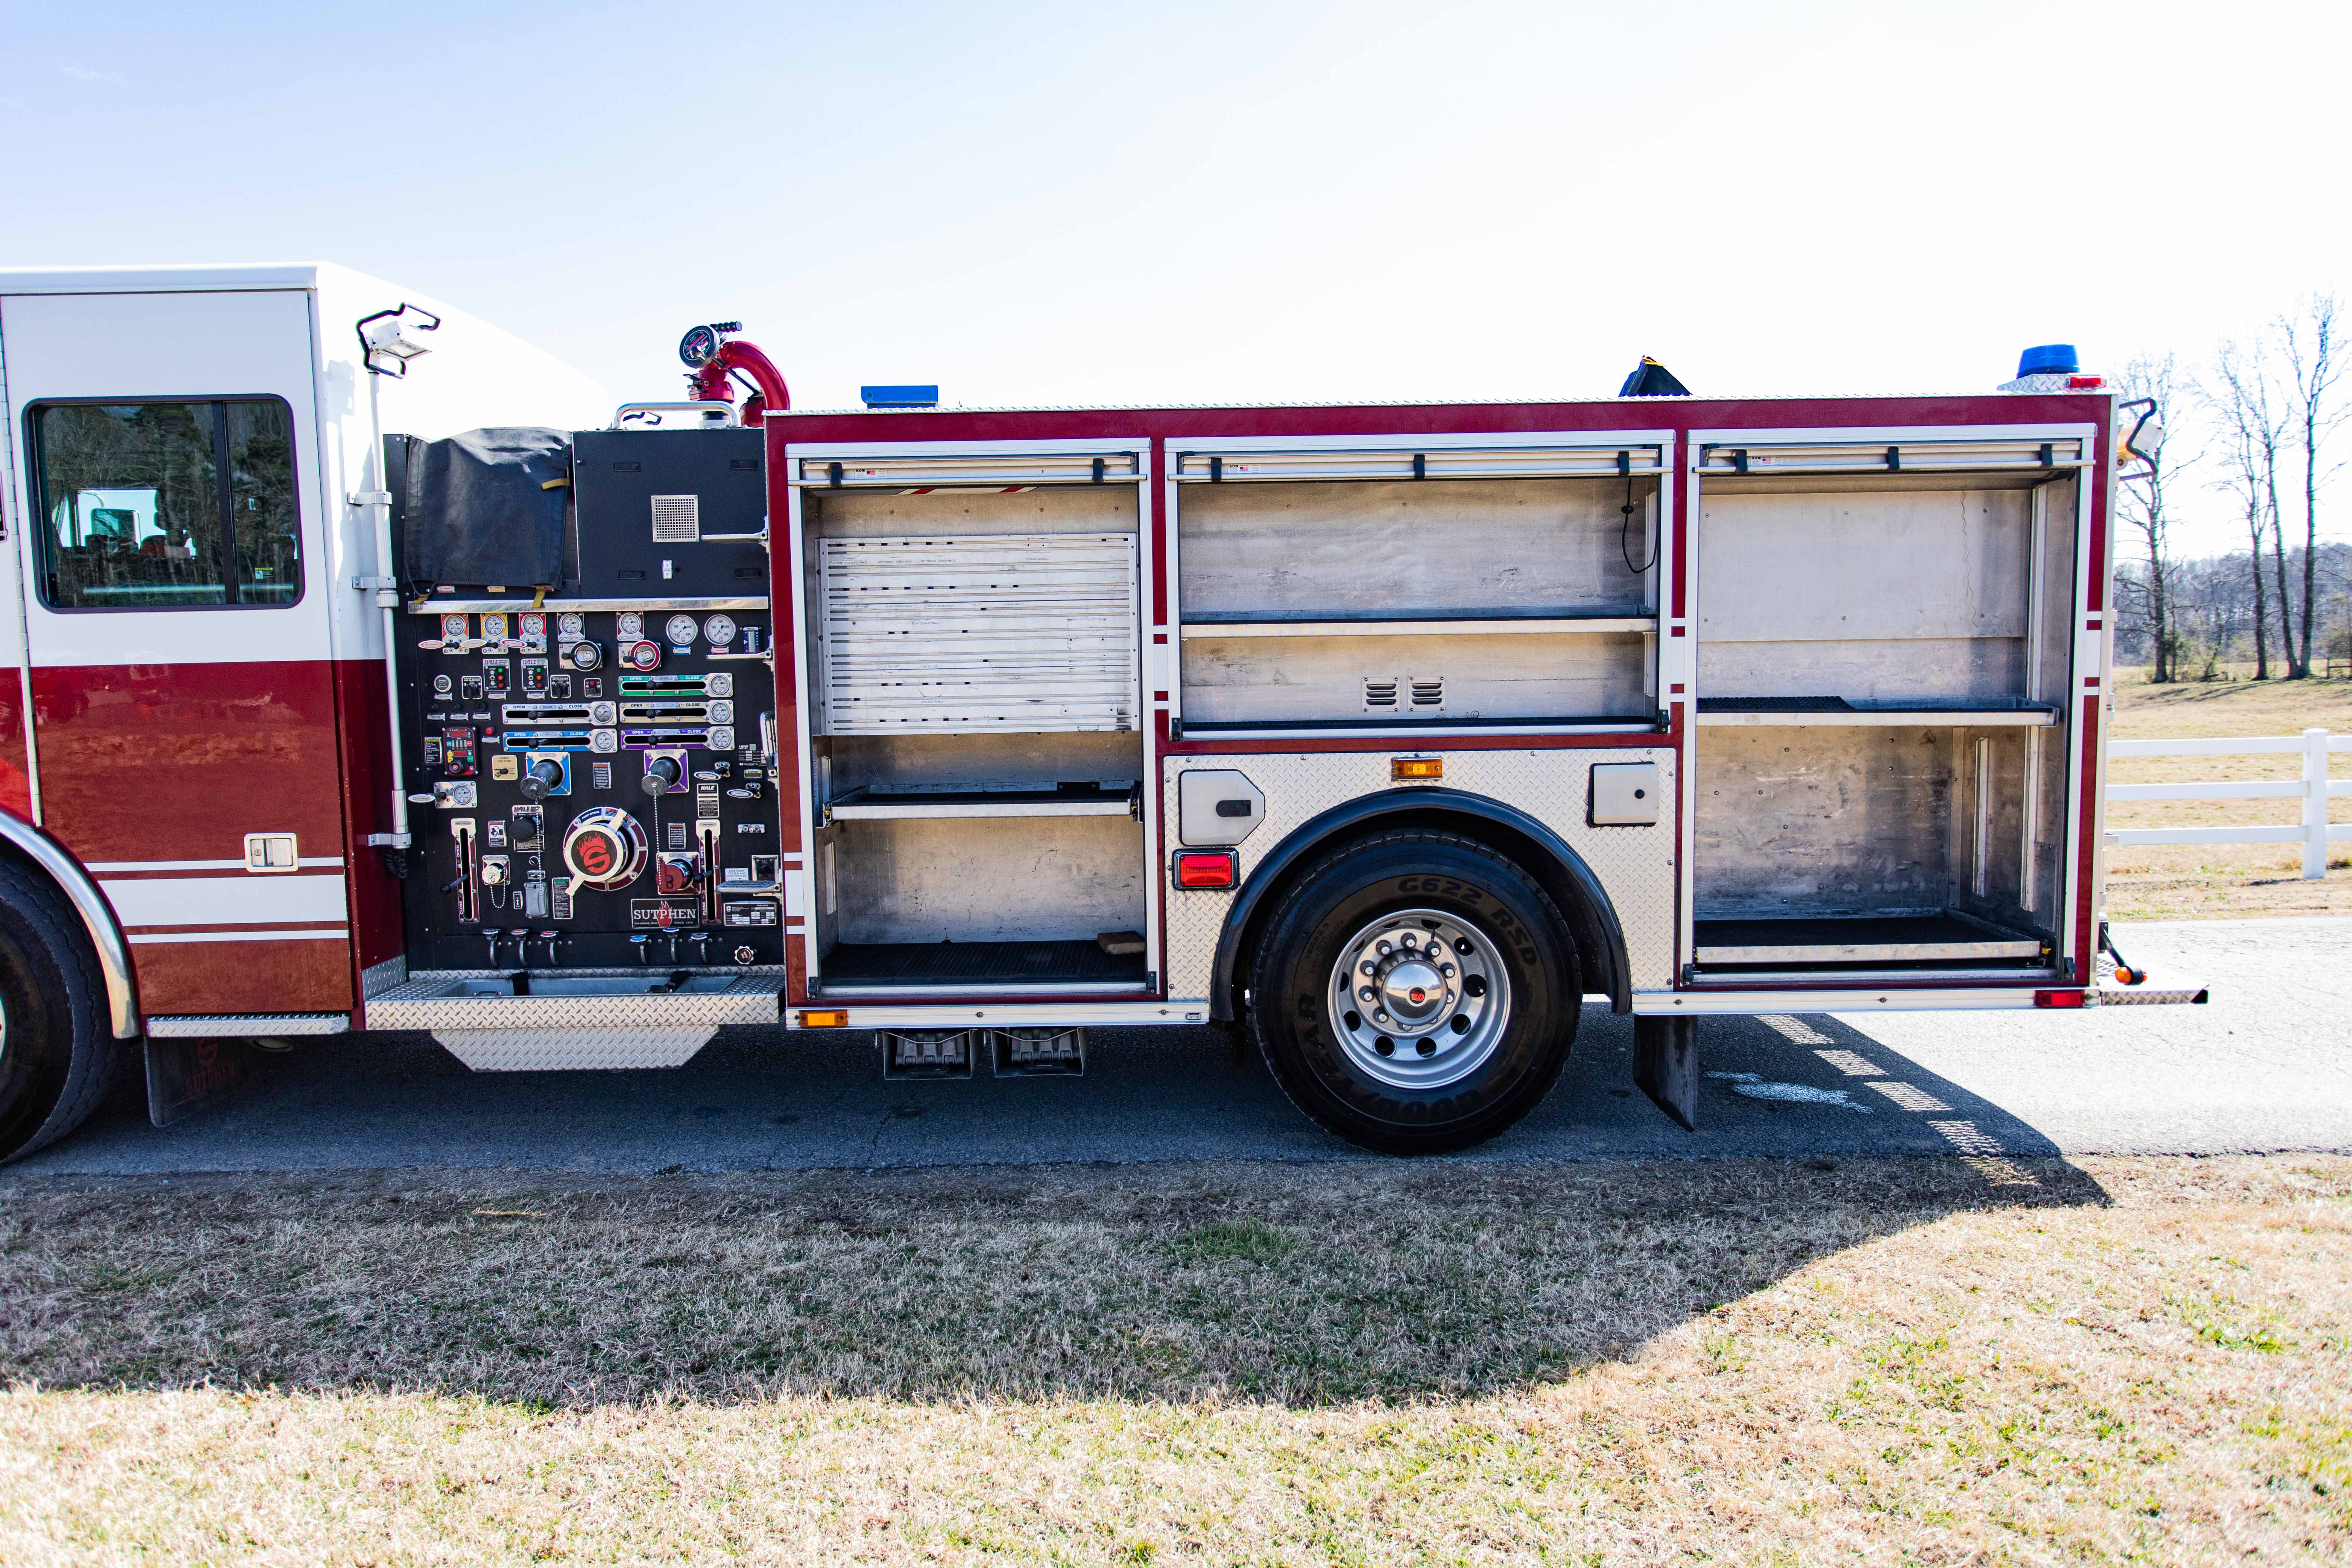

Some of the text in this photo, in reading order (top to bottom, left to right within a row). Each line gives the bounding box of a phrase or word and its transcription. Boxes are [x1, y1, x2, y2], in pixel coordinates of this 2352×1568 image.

[634, 909, 696, 920] SUTPHEN
[1398, 877, 1538, 966] G622 RSD
[185, 1060, 236, 1096] SUTPHEN
[1296, 993, 1481, 1121] GOODYEAR
